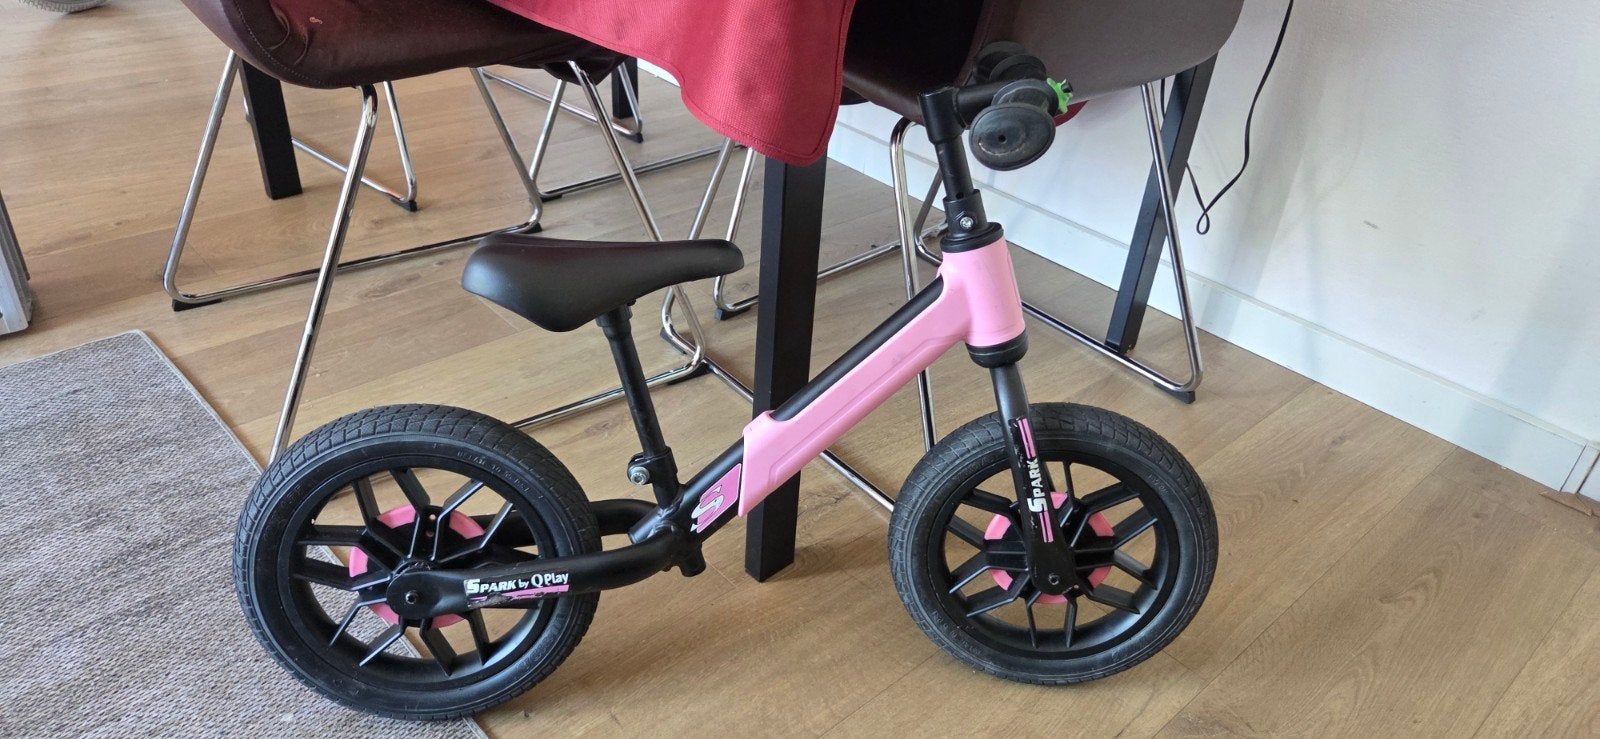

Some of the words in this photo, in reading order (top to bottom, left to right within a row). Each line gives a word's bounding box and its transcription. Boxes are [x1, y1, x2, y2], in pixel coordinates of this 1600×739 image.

[1027, 458, 1047, 512] SPARK
[465, 578, 517, 594] SPARK
[518, 578, 529, 589] by
